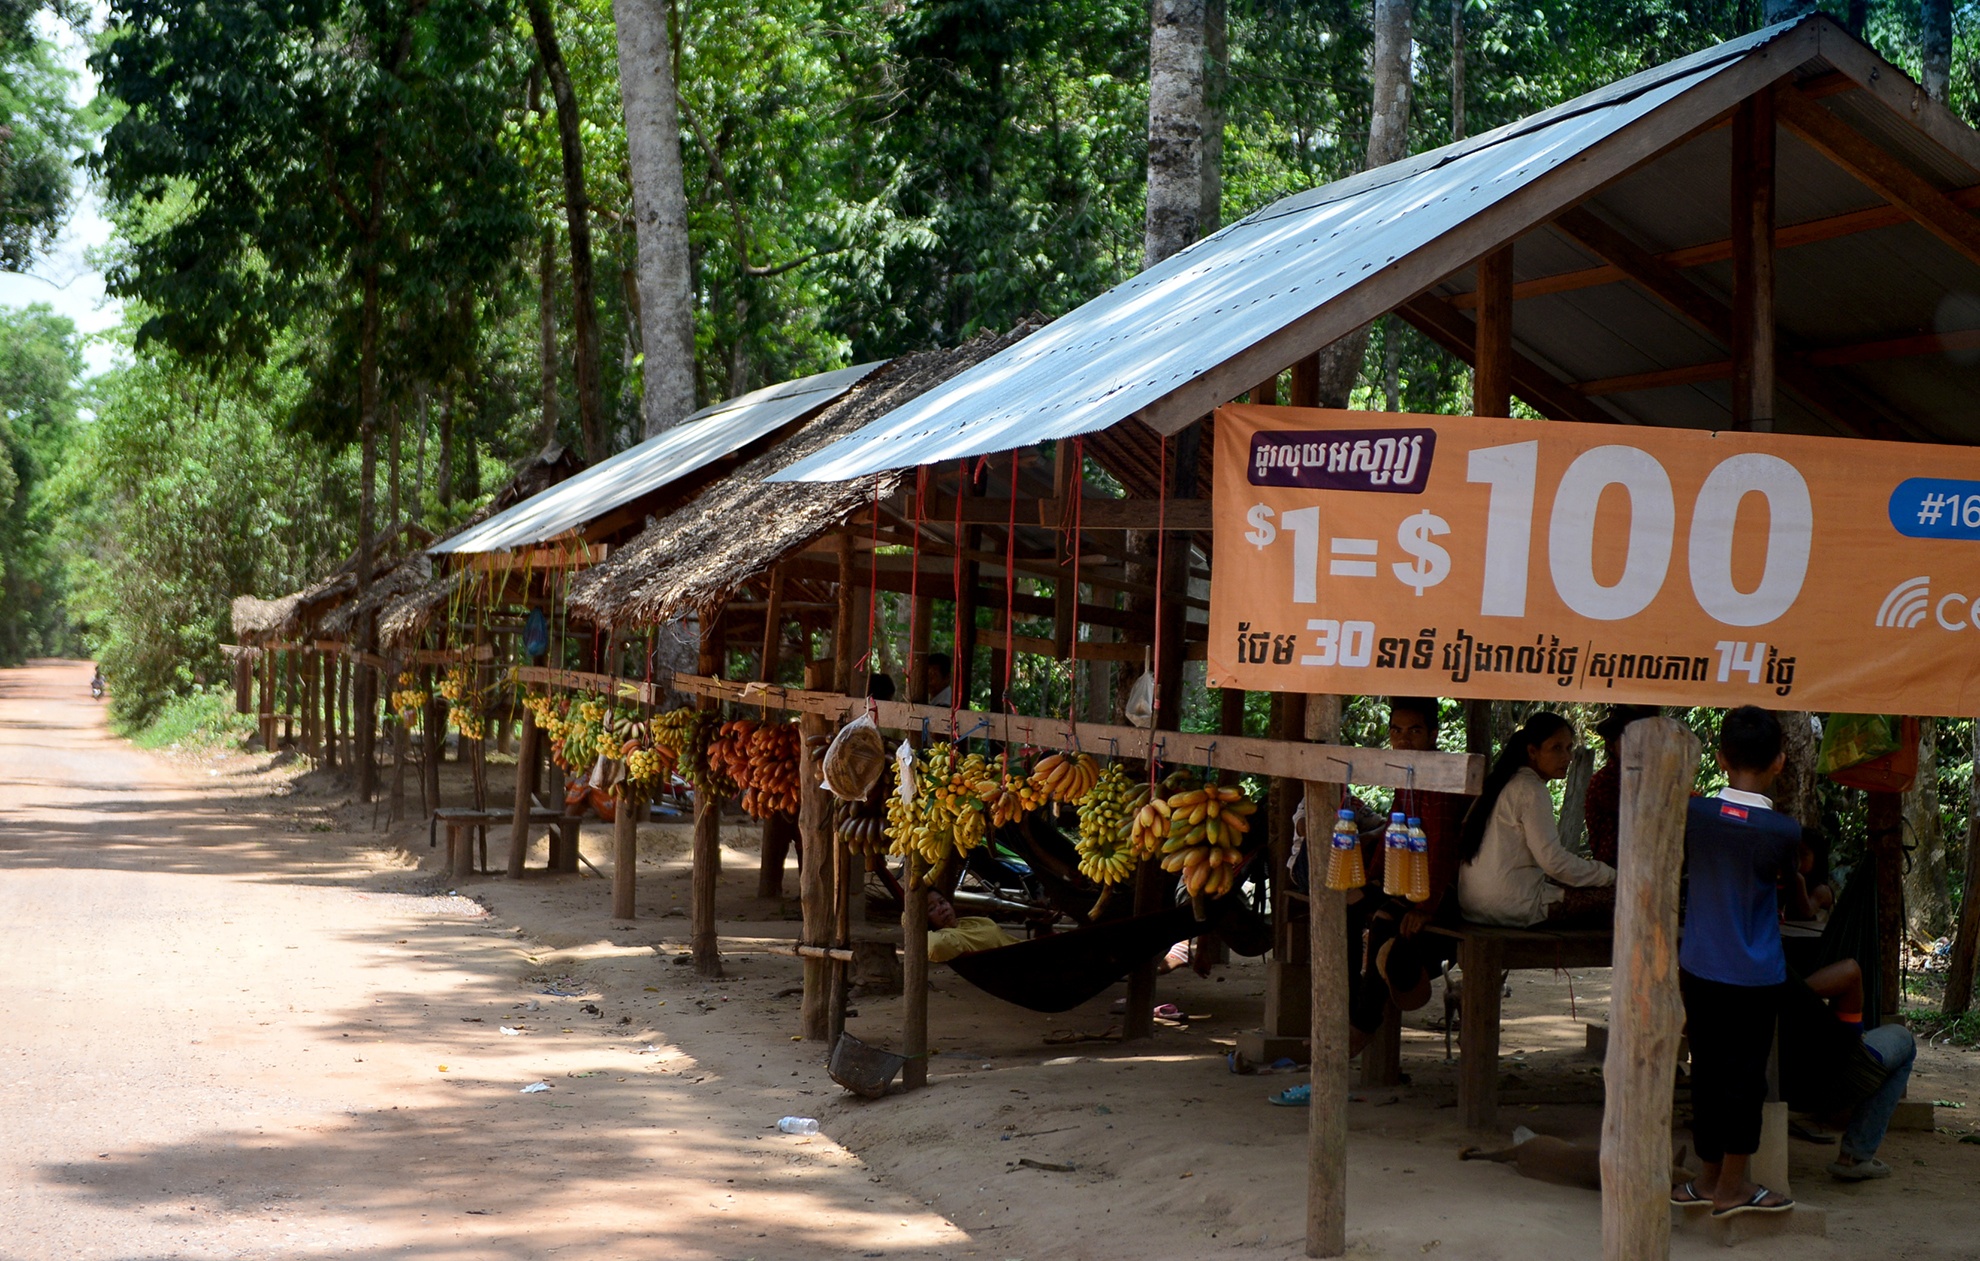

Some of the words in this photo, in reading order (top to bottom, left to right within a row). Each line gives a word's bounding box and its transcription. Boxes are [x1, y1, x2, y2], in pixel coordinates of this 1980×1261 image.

[1936, 592, 1980, 632] c
[1237, 622, 1297, 665] ថែម
[1301, 618, 1375, 668] 30
[1589, 652, 1709, 688] សុពលភាព
[1714, 640, 1767, 684] 14
